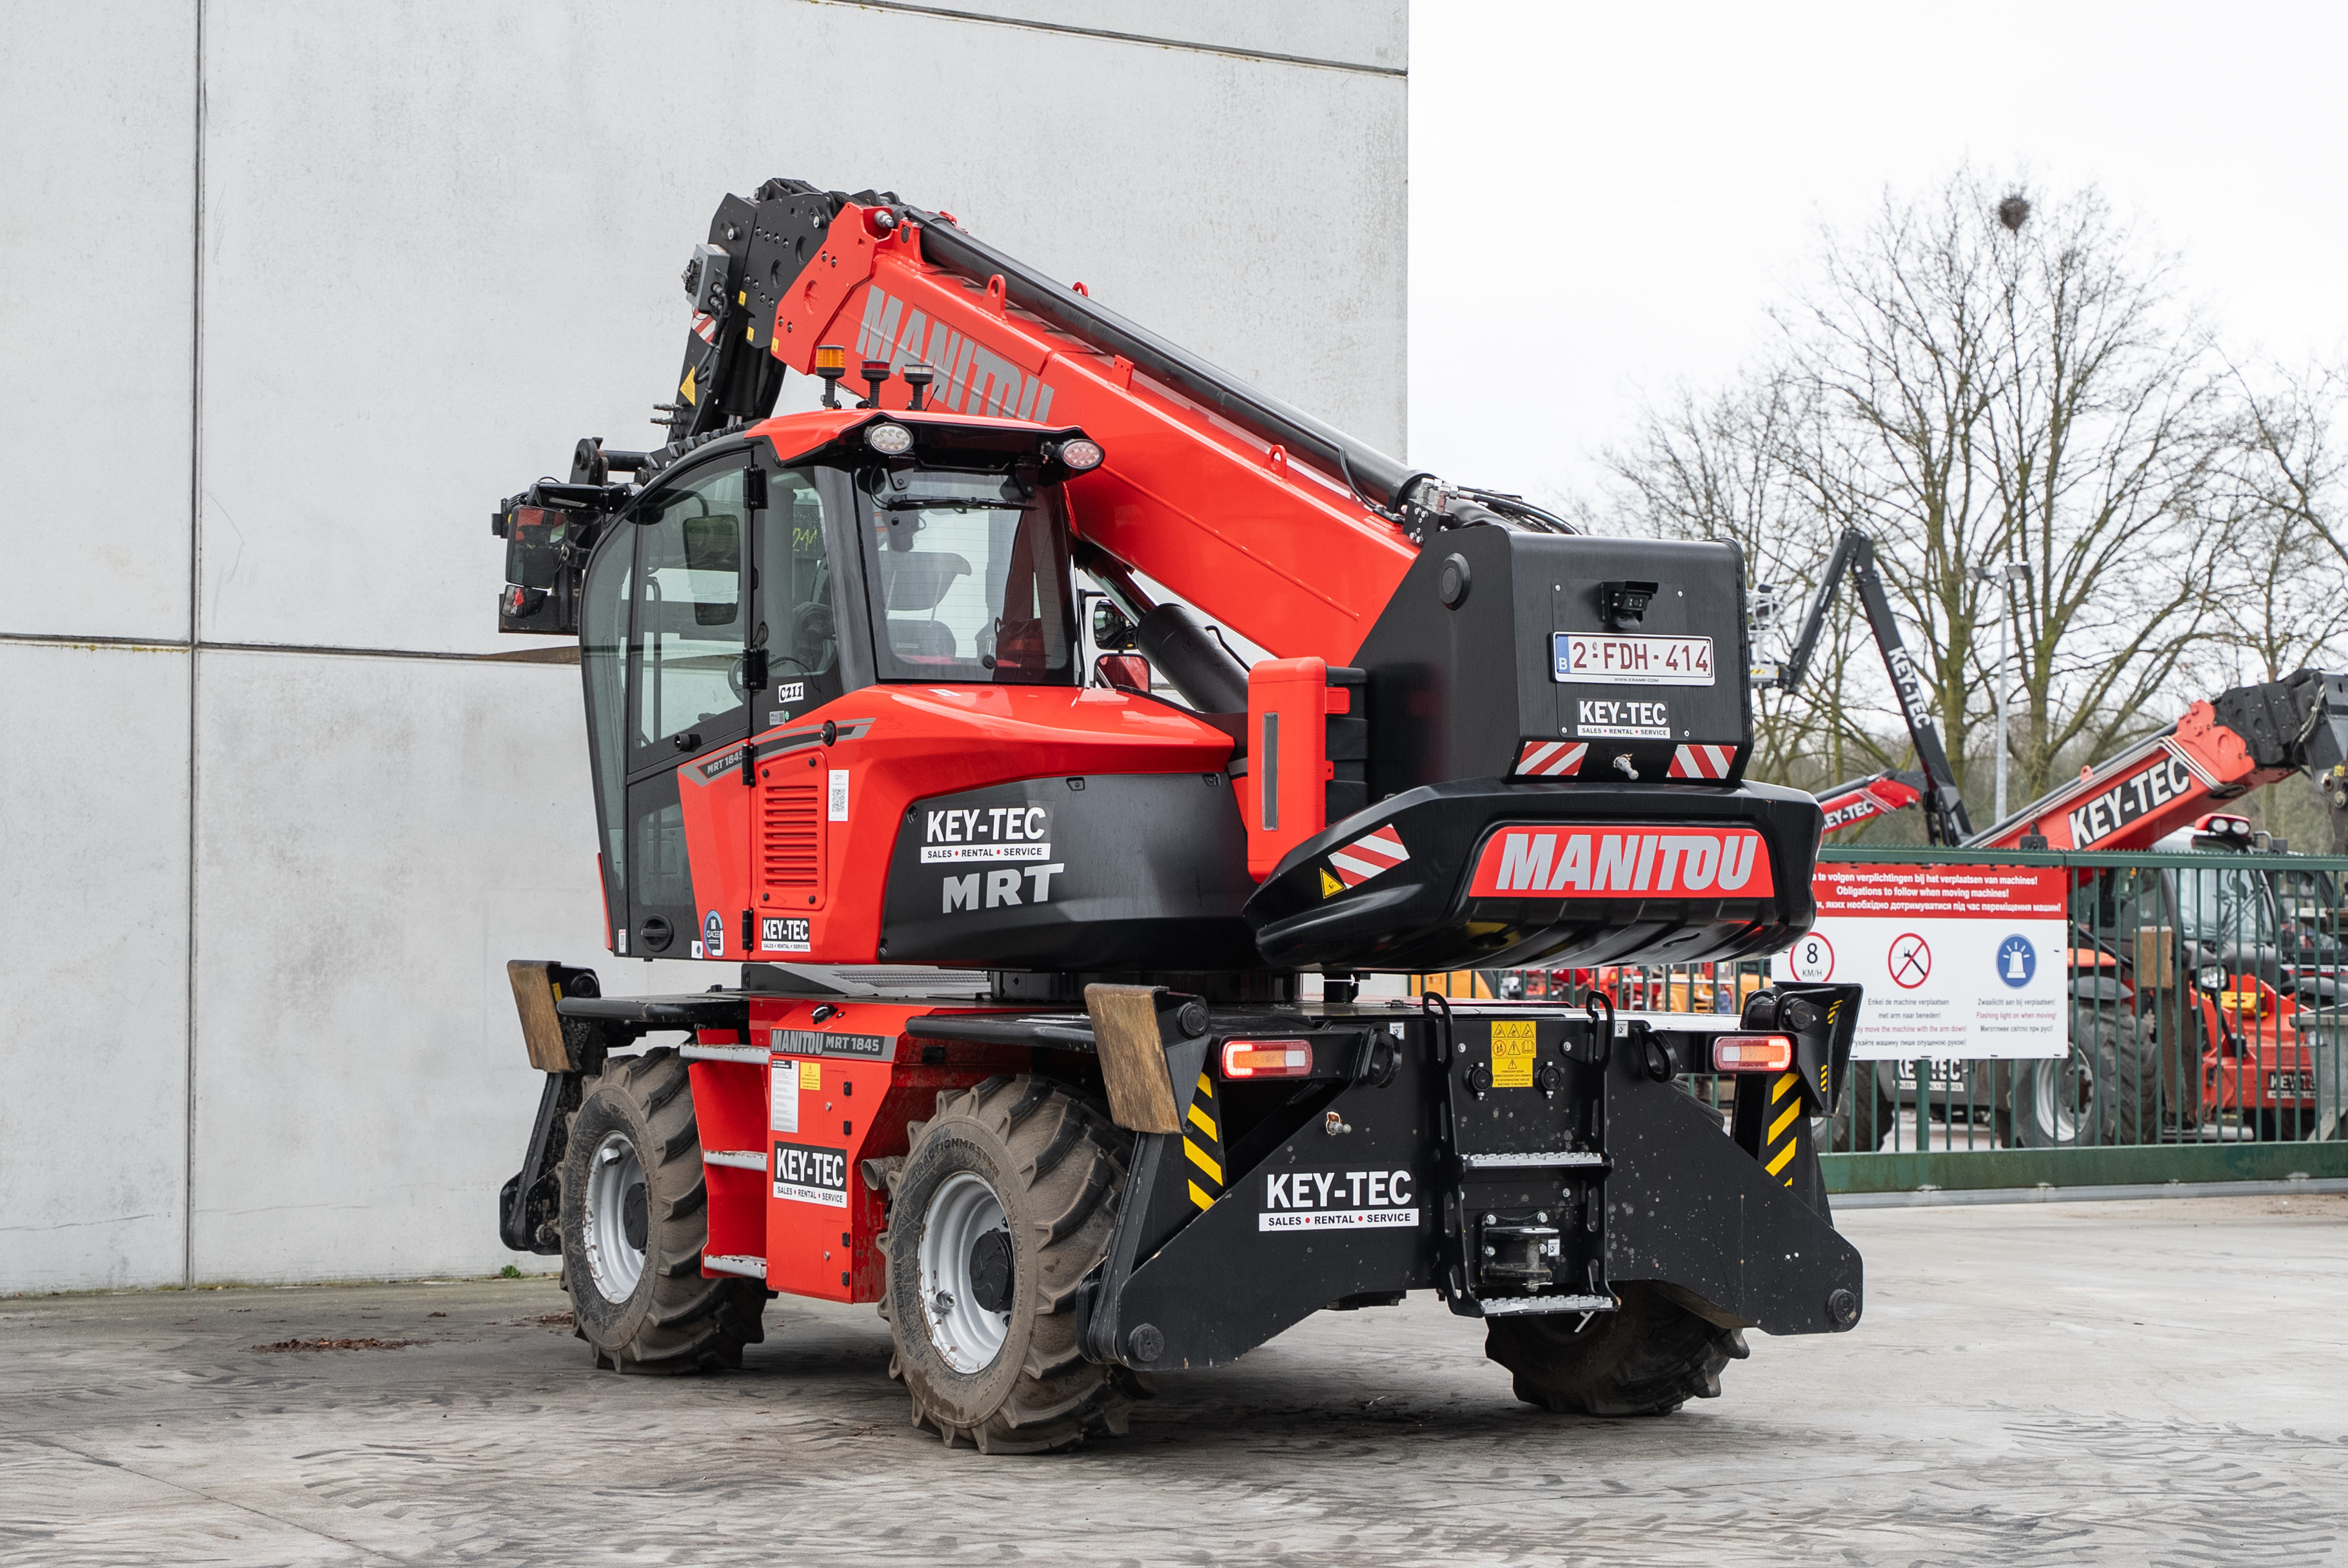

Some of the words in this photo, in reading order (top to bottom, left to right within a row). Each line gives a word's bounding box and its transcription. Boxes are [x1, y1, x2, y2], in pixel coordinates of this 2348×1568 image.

[856, 284, 1054, 423] MANITOU
[1559, 658, 1568, 670] B
[780, 685, 802, 701] C211
[1888, 645, 1931, 729] KEY-TEC
[1580, 700, 1667, 725] KEY-TEC
[707, 759, 724, 774] MRT
[2069, 755, 2190, 850] KEY-TEC
[927, 807, 1046, 843] KEY-TEC
[1824, 799, 1875, 830] EY-TEC
[962, 849, 993, 858] RENTAL
[1003, 848, 1042, 856] SERVICE
[1495, 833, 1759, 890] MANITOU
[942, 863, 1065, 914] MRT
[1818, 873, 1826, 881] te
[1828, 872, 1855, 884] volgen
[1857, 873, 1913, 884] verplichtingen
[1915, 874, 1925, 885] bij
[1926, 875, 1939, 883] het
[1940, 875, 1983, 885] verplaatsen
[2000, 876, 2038, 885] machines!
[1837, 885, 1883, 897] Obligations
[1884, 887, 1893, 896] to
[1893, 887, 1919, 896] follow
[1920, 888, 1941, 897] when
[1942, 888, 1970, 899] moving
[1971, 888, 2009, 898] machines!
[763, 919, 809, 940] KEY-TEC
[1807, 943, 1818, 964] 8
[1802, 969, 1822, 977] KM/H
[1919, 999, 1949, 1007] verplaatsen
[1977, 1012, 1998, 1021] Flashing
[2000, 1012, 2011, 1021] light
[2036, 1012, 2057, 1021] moving!
[1855, 1025, 1864, 1034] nly
[771, 1030, 824, 1055] MANITOU
[825, 1036, 849, 1049] MRT
[851, 1037, 879, 1052] 1845
[776, 1148, 844, 1187] KEY-TEC
[777, 1186, 793, 1195] SALES
[798, 1189, 816, 1199] RENTAL
[822, 1192, 843, 1203] SERVICE
[1267, 1170, 1412, 1209] KEY-TEC
[1268, 1217, 1301, 1226] SALES
[1314, 1215, 1355, 1225] RENTAL
[1366, 1213, 1410, 1223] SERVICE
